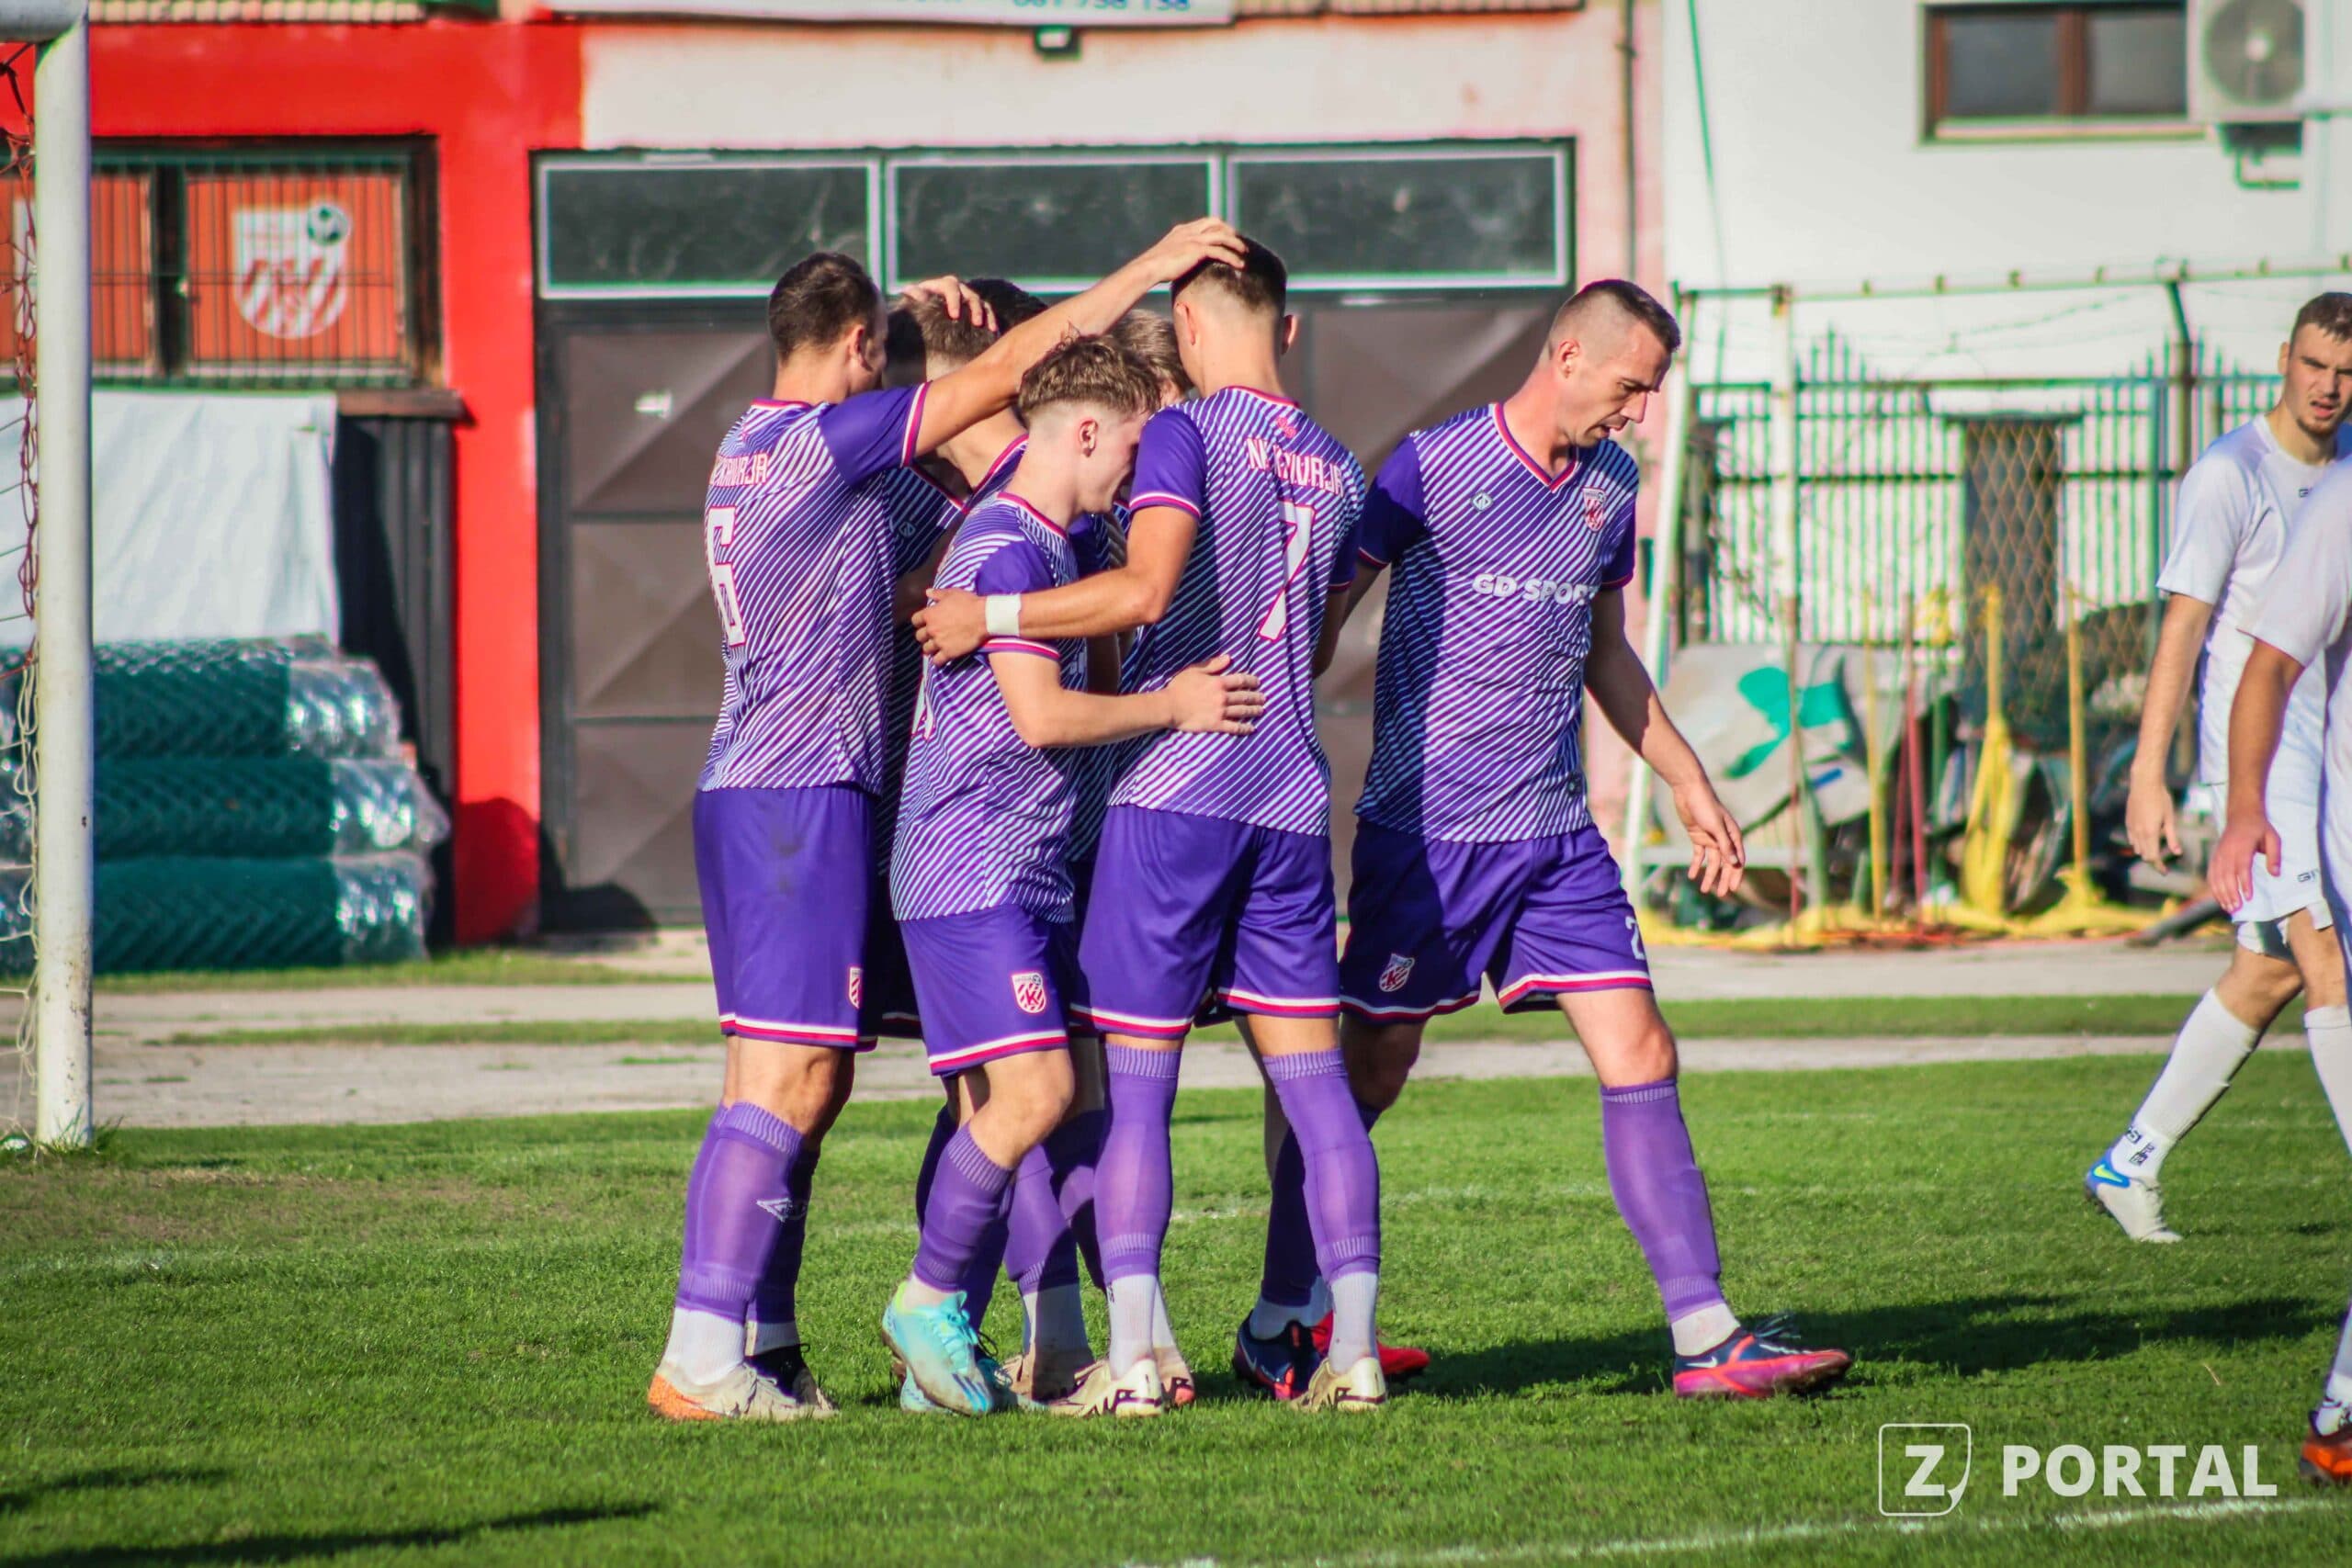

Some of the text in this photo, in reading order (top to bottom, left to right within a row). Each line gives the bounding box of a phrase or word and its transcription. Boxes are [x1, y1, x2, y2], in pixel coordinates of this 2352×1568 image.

[706, 506, 746, 647] 6
[1258, 499, 1316, 644] 7
[1472, 573, 1518, 598] GD
